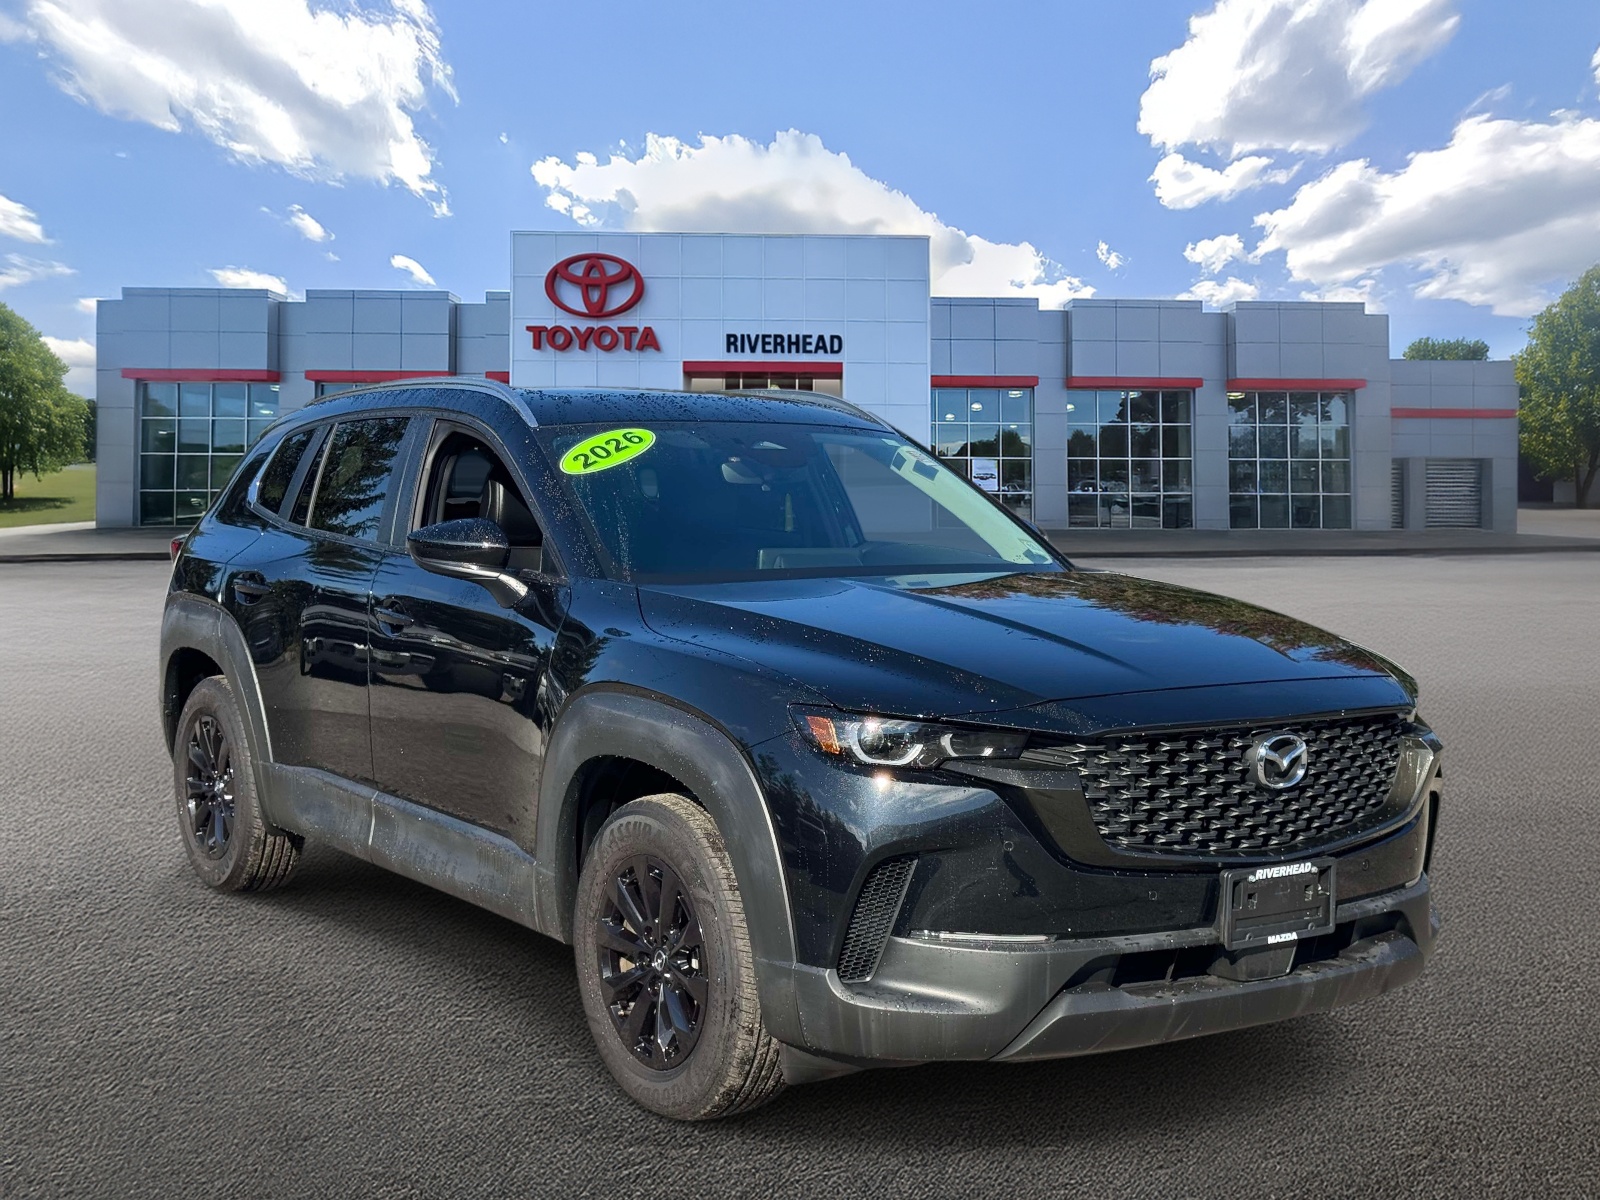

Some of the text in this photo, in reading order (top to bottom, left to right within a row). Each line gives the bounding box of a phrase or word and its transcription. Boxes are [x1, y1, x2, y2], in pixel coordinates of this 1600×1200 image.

[525, 325, 661, 352] TOYOTA
[725, 333, 844, 355] RIVERHEAD
[572, 431, 644, 470] 2026
[1255, 862, 1312, 881] RIVERHEAD
[1267, 932, 1298, 944] MAZDA
